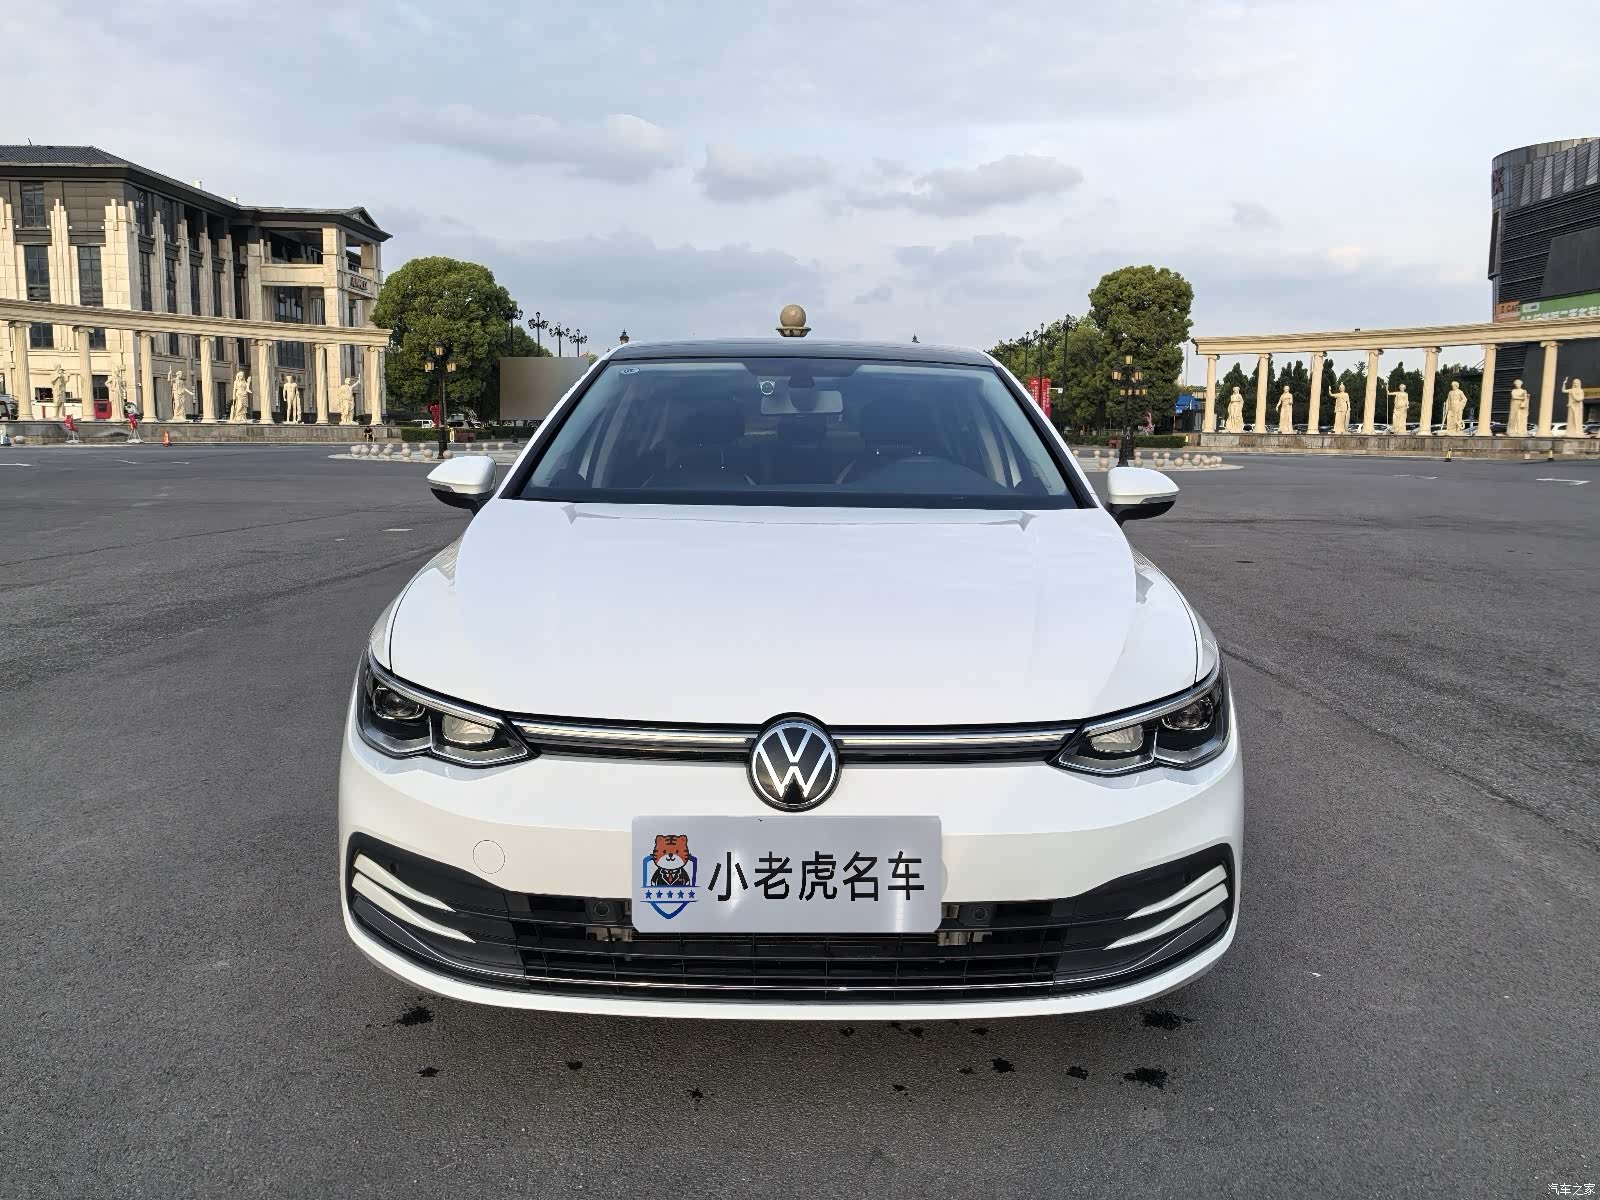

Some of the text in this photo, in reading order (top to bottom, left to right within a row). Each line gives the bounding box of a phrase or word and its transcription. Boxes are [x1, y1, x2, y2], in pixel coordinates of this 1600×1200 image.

[707, 850, 925, 902] 小老虎名车
